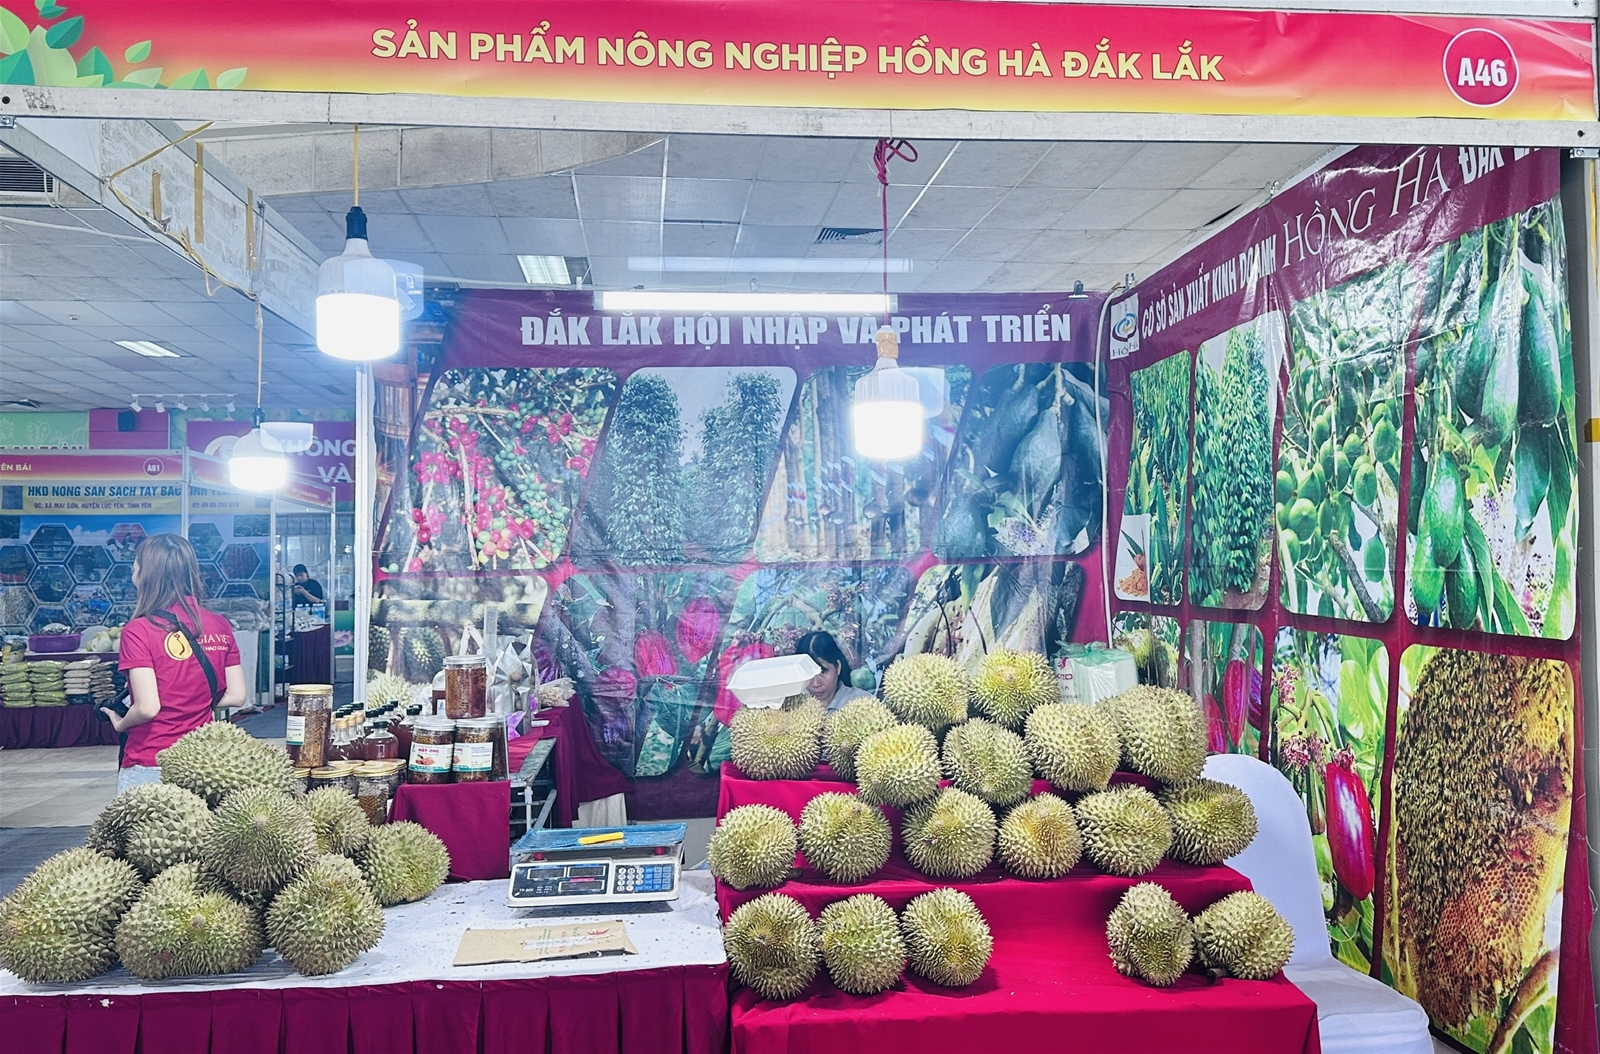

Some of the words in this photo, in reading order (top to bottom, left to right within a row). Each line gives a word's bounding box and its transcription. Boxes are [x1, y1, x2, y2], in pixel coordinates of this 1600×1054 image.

[371, 18, 458, 60] SẢN
[469, 20, 586, 65] PHẨM
[597, 30, 713, 69] NÔNG
[724, 36, 868, 79] NGHIỆP
[877, 34, 988, 76] HỒNG
[998, 41, 1052, 78] HÀ
[1061, 36, 1143, 79] ĐẮK
[1151, 38, 1226, 81] LẮK
[1457, 57, 1508, 87] A46
[1142, 301, 1155, 339] CƠ
[1186, 262, 1210, 318] XUẤT
[1212, 257, 1237, 304] KINH
[1239, 234, 1277, 289] DOANH
[1282, 187, 1376, 269] HỒNG
[520, 307, 591, 346] ĐẮK
[602, 310, 663, 346] LẮK
[673, 311, 730, 350] HỘI
[742, 312, 828, 350] NHẬP
[837, 313, 879, 344] VÀ
[891, 311, 972, 344] PHÁT
[981, 303, 1071, 342] TRIỂN
[0, 462, 13, 471] ÊN
[15, 462, 32, 471] BÁI
[317, 462, 353, 483] VÀ
[28, 486, 49, 497] HKD
